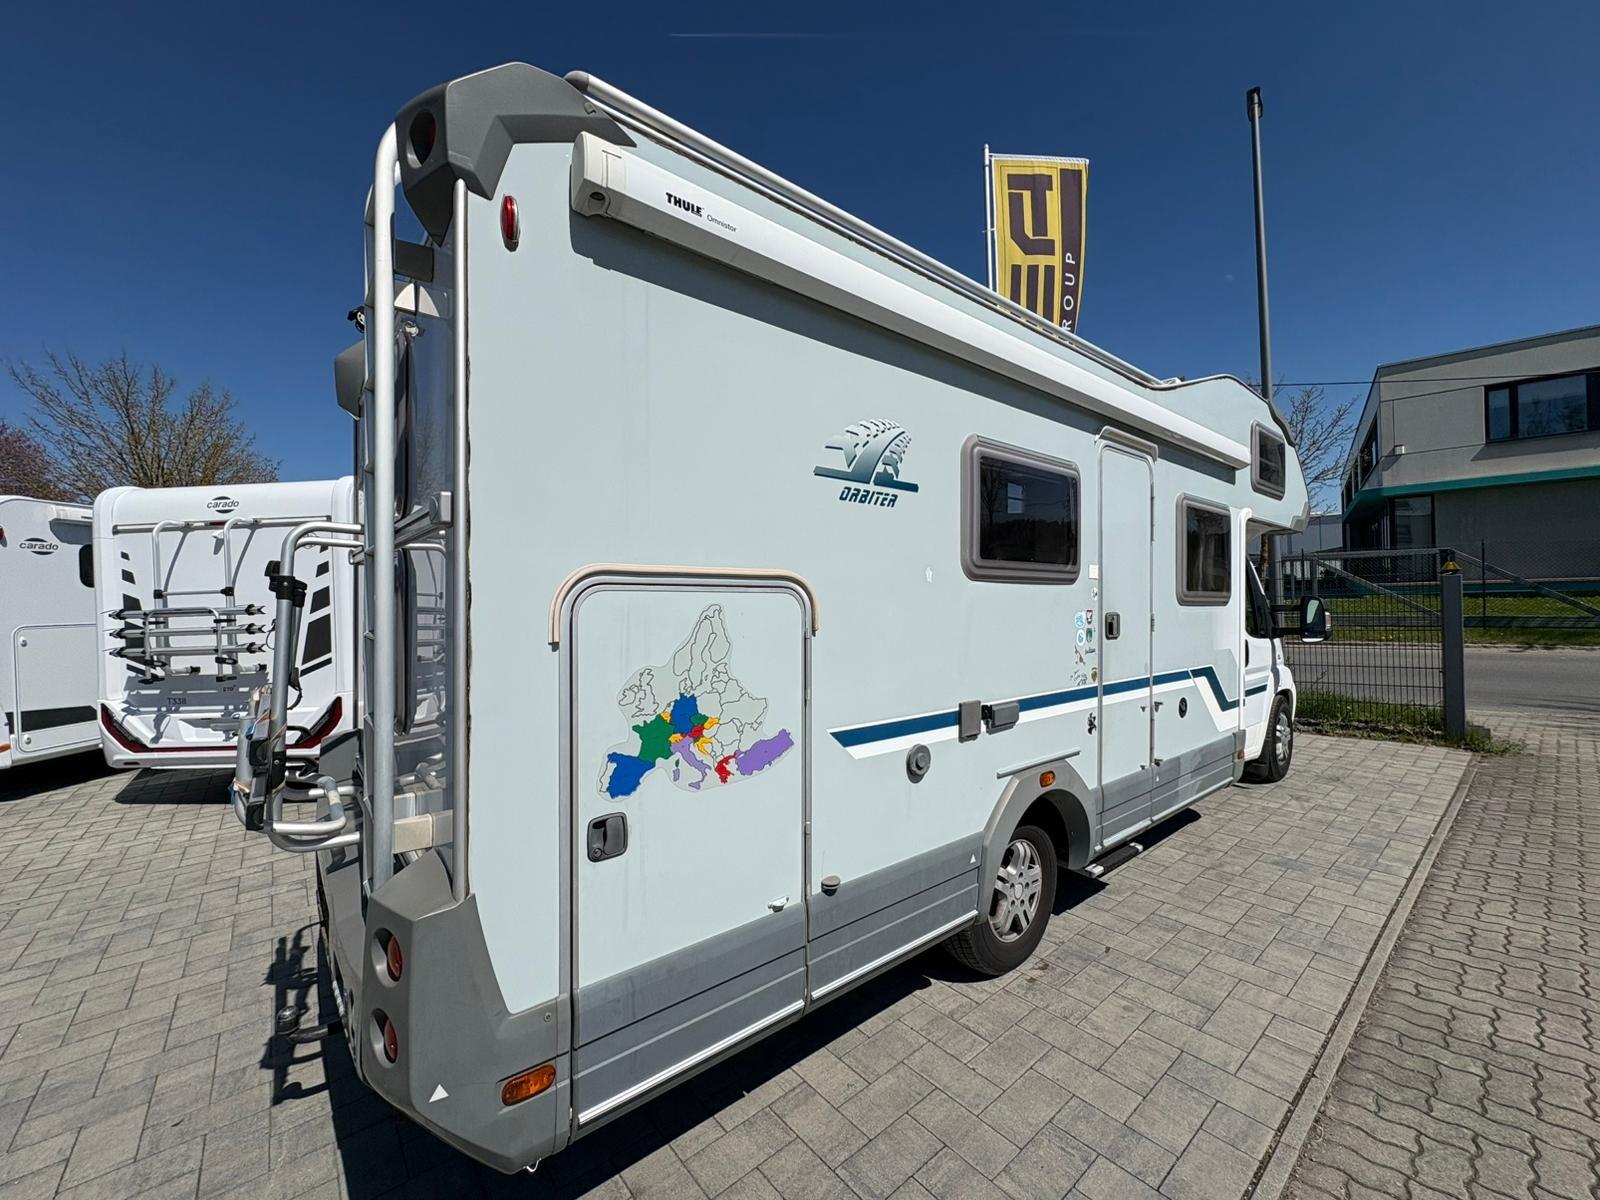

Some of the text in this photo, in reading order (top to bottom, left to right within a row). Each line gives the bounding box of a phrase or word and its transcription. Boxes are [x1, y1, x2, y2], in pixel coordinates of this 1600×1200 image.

[665, 192, 737, 233] THULE Omnistor
[206, 500, 240, 509] carado
[839, 486, 899, 508] ORBITER
[19, 542, 59, 551] carado
